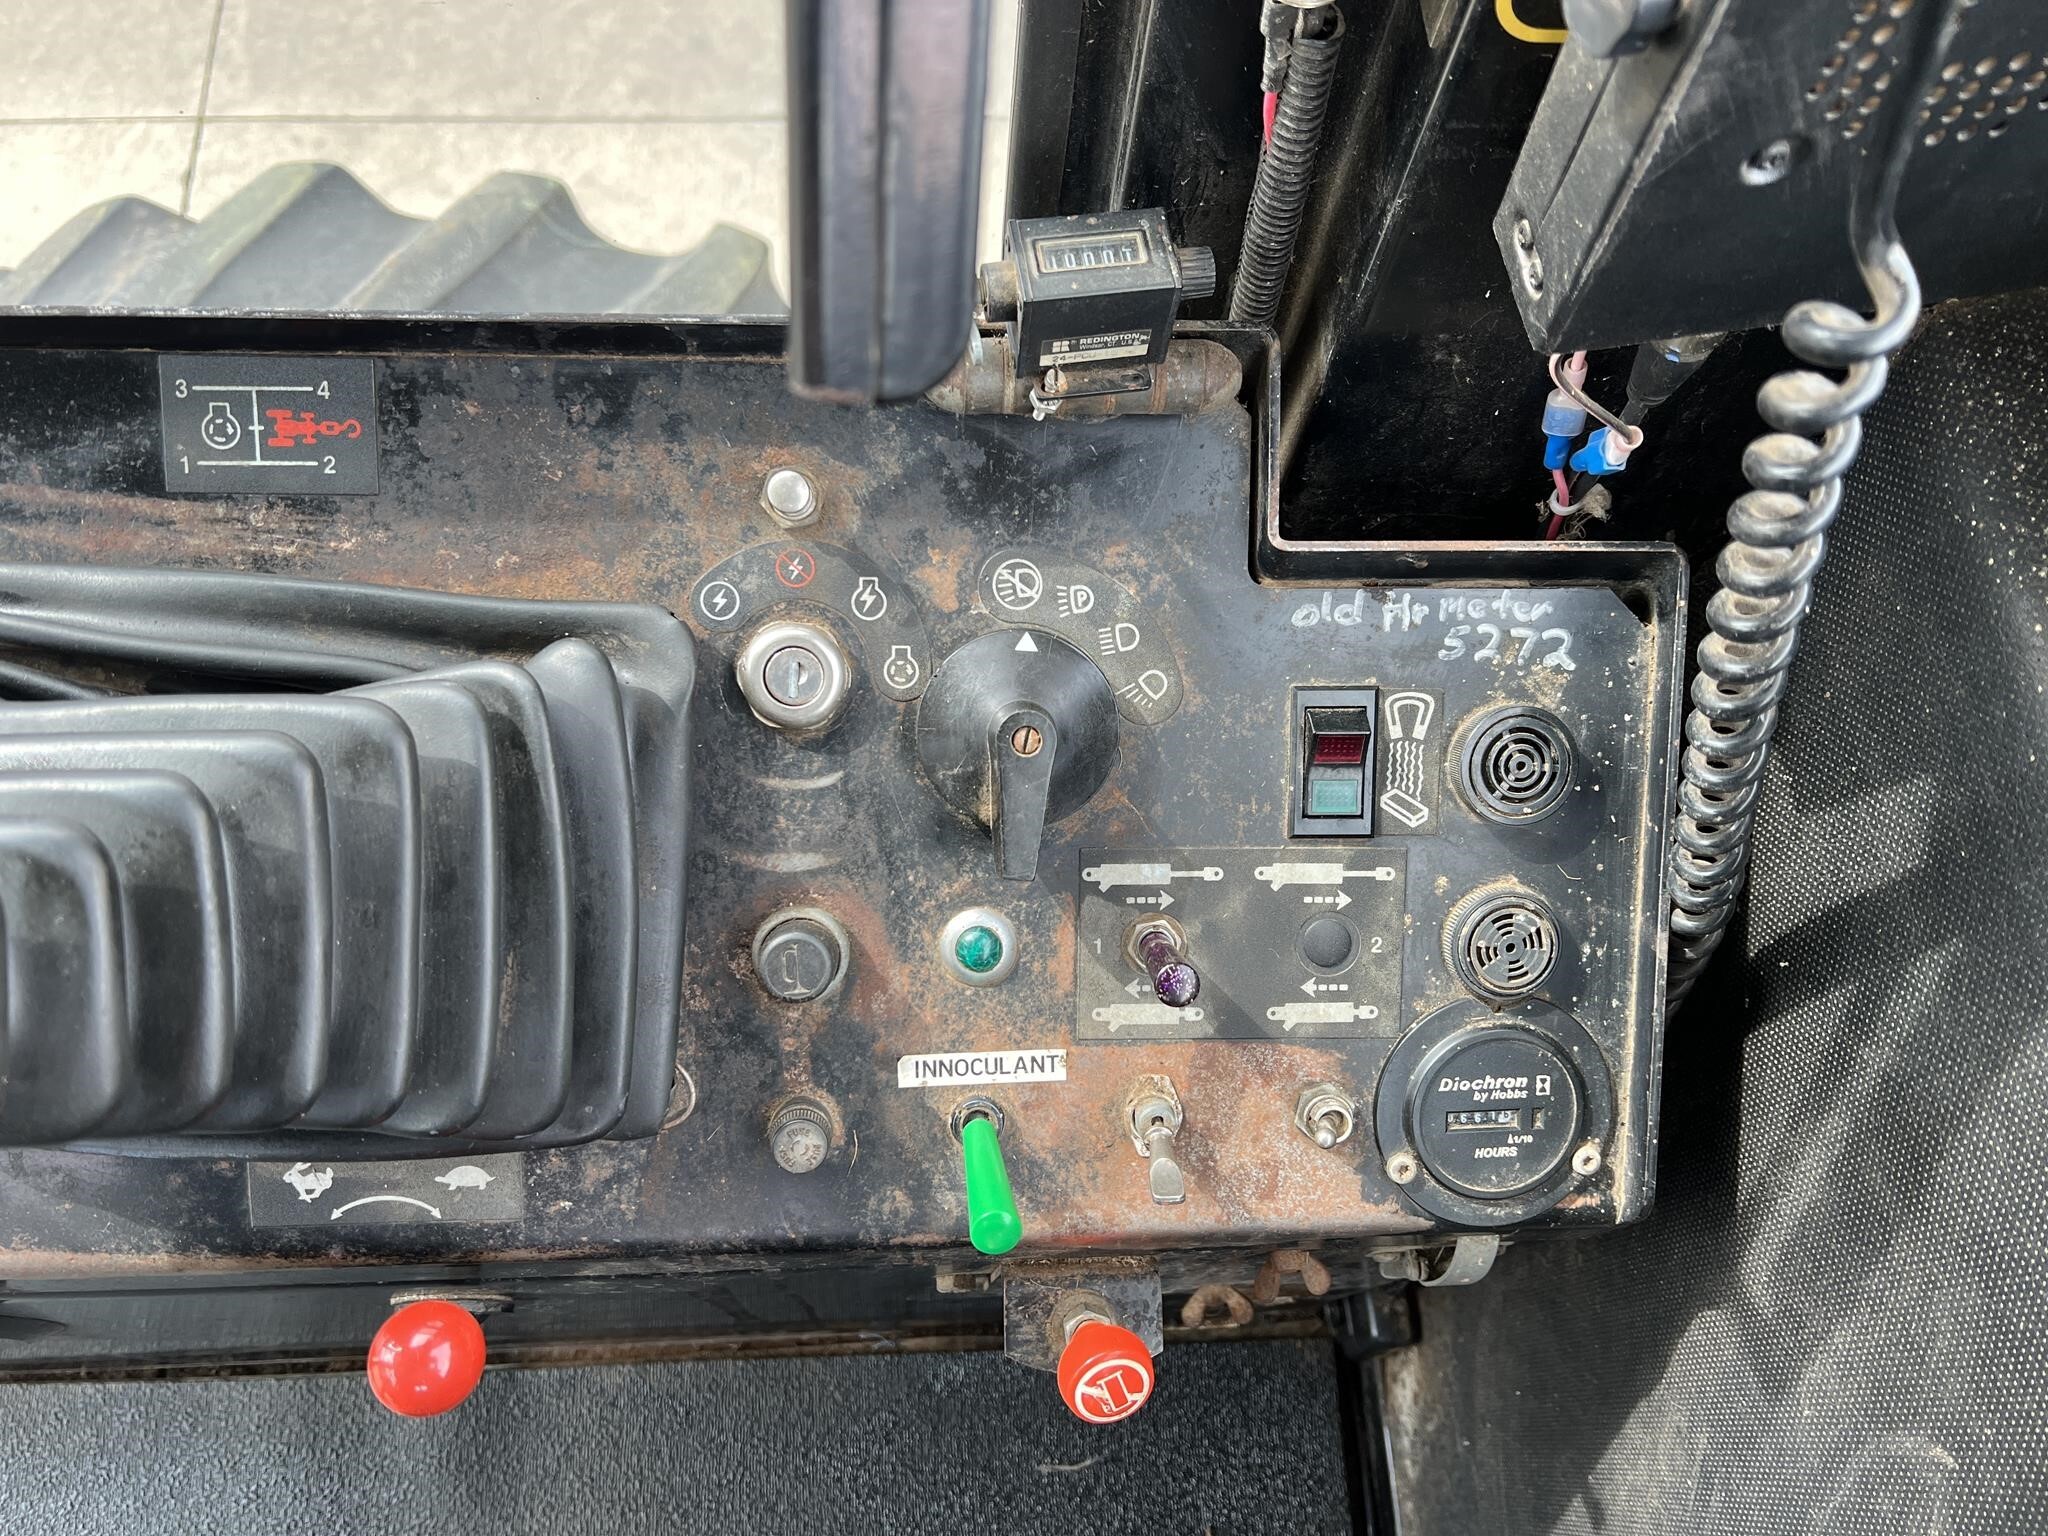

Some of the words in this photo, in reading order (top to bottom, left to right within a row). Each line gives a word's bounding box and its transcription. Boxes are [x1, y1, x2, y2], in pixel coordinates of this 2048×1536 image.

[1080, 333, 1140, 345] REDINGTON
[175, 379, 189, 399] 3
[317, 380, 331, 400] 4
[180, 455, 190, 474] 1
[323, 455, 337, 475] 2
[1291, 589, 1365, 628] old
[1437, 623, 1577, 671] 5272
[1093, 938, 1102, 954] 1
[1371, 936, 1383, 953] 2
[914, 1054, 1059, 1079] INNOCULANT
[1438, 1075, 1529, 1092] Diochron
[1473, 1091, 1487, 1103] by
[1490, 1089, 1529, 1100] Hobbs
[1474, 1146, 1518, 1159] HOURS
